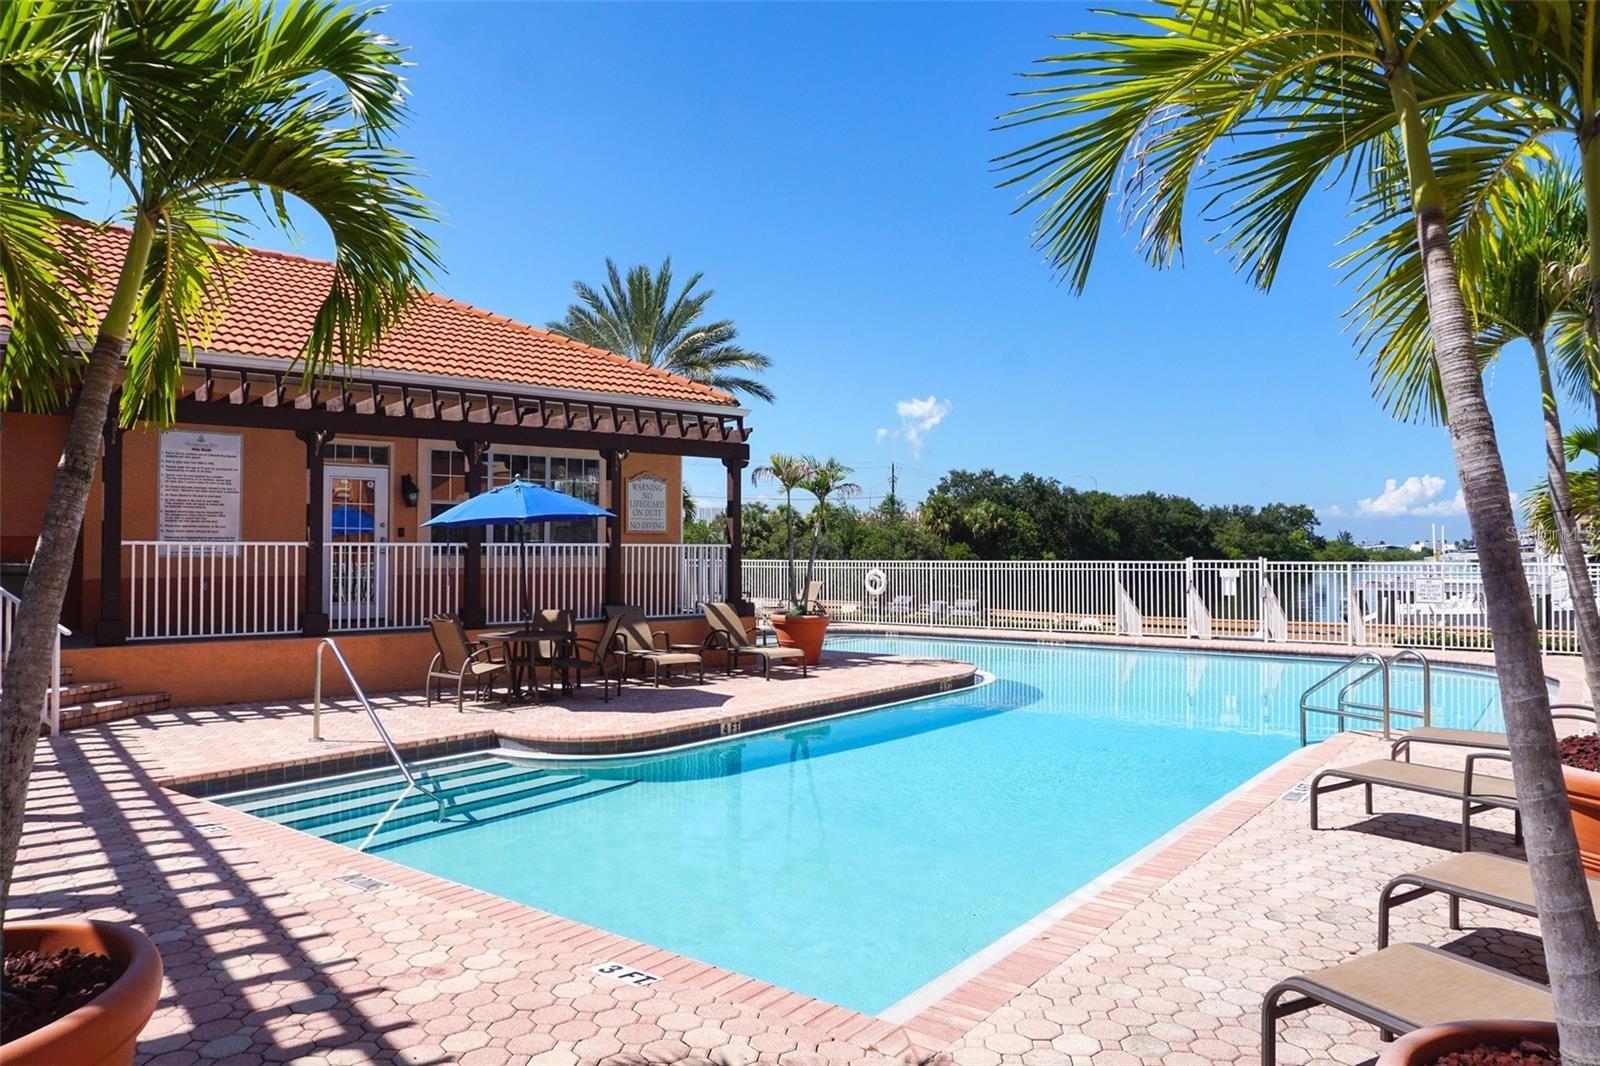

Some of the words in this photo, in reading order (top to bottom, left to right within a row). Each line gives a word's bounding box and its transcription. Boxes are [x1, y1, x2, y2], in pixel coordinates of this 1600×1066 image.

[631, 483, 664, 491] WARNING
[630, 500, 665, 508] LIFEGUARD
[632, 508, 643, 516] ON
[630, 521, 640, 529] NO
[641, 521, 665, 529] DIVING
[723, 723, 728, 733] 4
[731, 721, 740, 733] FT
[598, 965, 623, 974] 3
